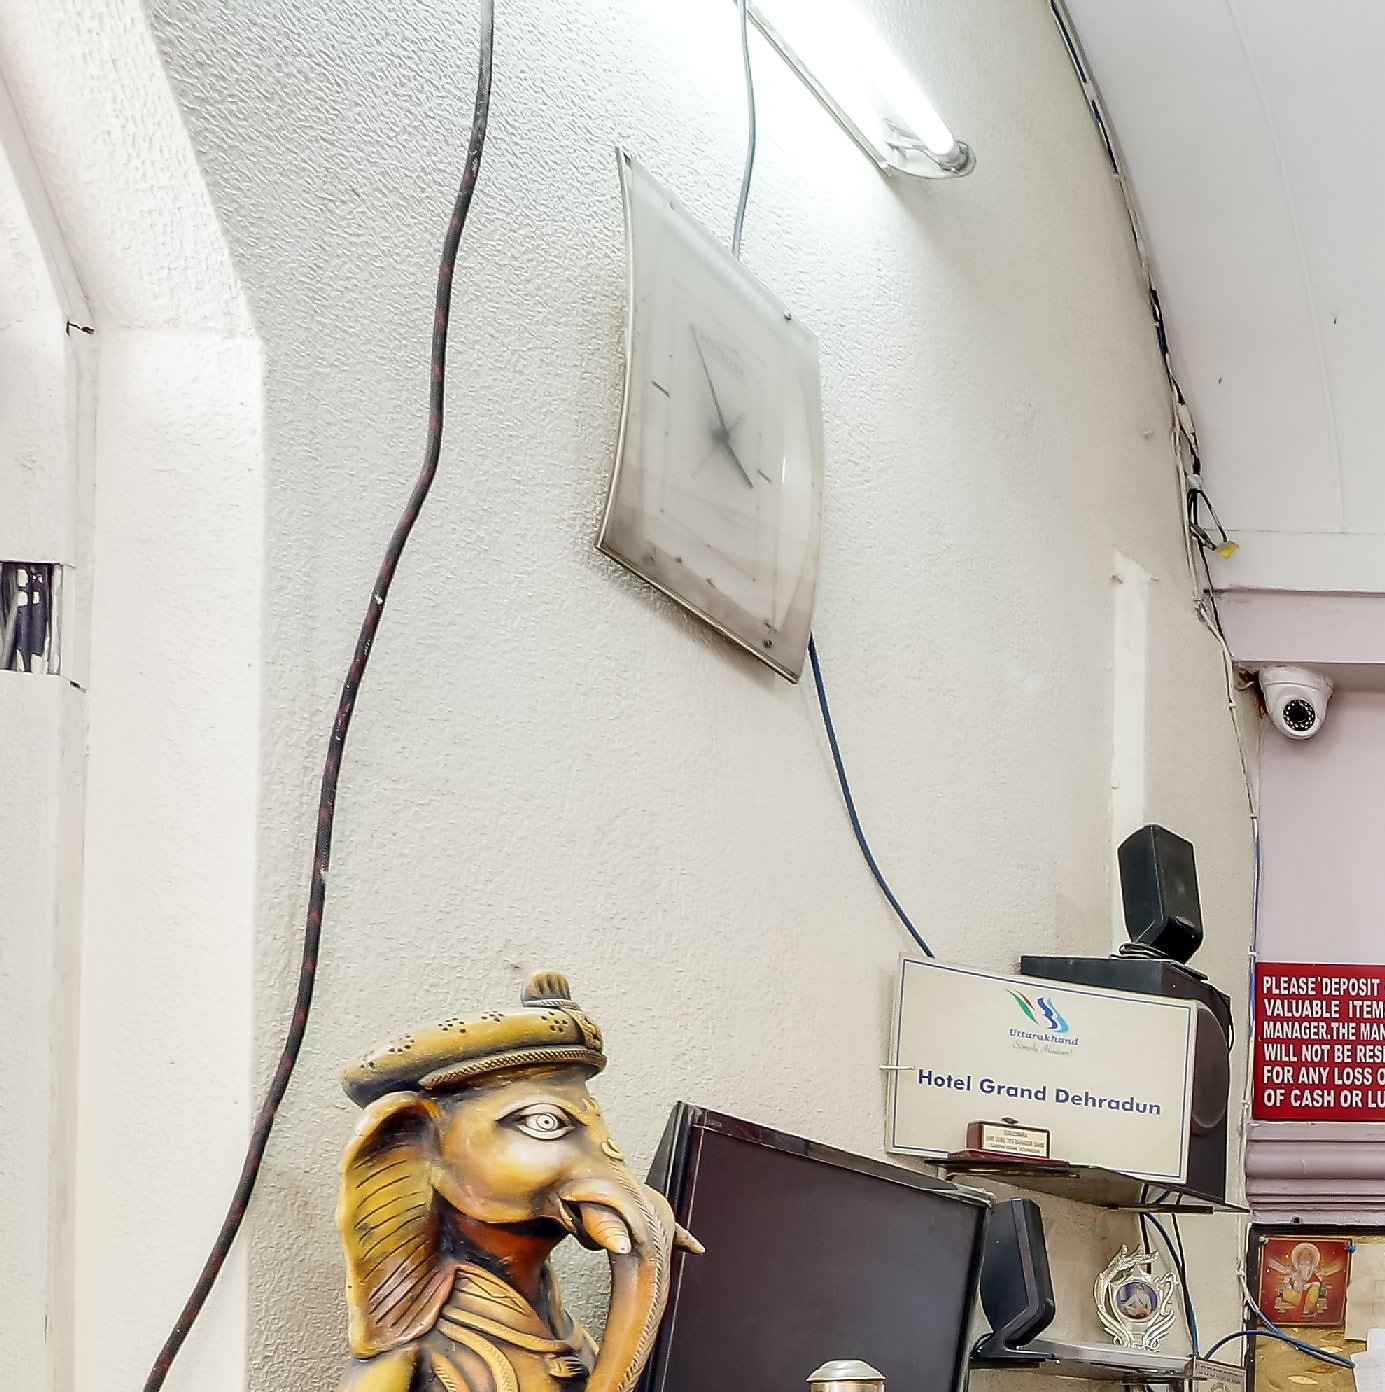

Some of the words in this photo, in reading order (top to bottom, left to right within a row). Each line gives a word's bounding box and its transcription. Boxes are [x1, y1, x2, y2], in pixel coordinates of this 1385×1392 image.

[1264, 976, 1316, 994] PLEASE
[1322, 978, 1380, 995] DEPOSIT
[1264, 999, 1339, 1017] VALUABLE
[1009, 1028, 1079, 1046] Uttarakhand
[1264, 1044, 1297, 1061] WILL
[1302, 1045, 1330, 1062] NOT
[1334, 1045, 1351, 1062] BE
[1264, 1066, 1293, 1084] FOR
[1298, 1067, 1329, 1084] ANY
[1334, 1068, 1372, 1085] LOSS
[918, 1069, 971, 1091] Hotel
[980, 1078, 1046, 1101] Grand
[1055, 1088, 1161, 1115] Dehradun
[1264, 1090, 1285, 1106] OF
[1291, 1090, 1334, 1107] CASH
[1340, 1091, 1363, 1107] OR
